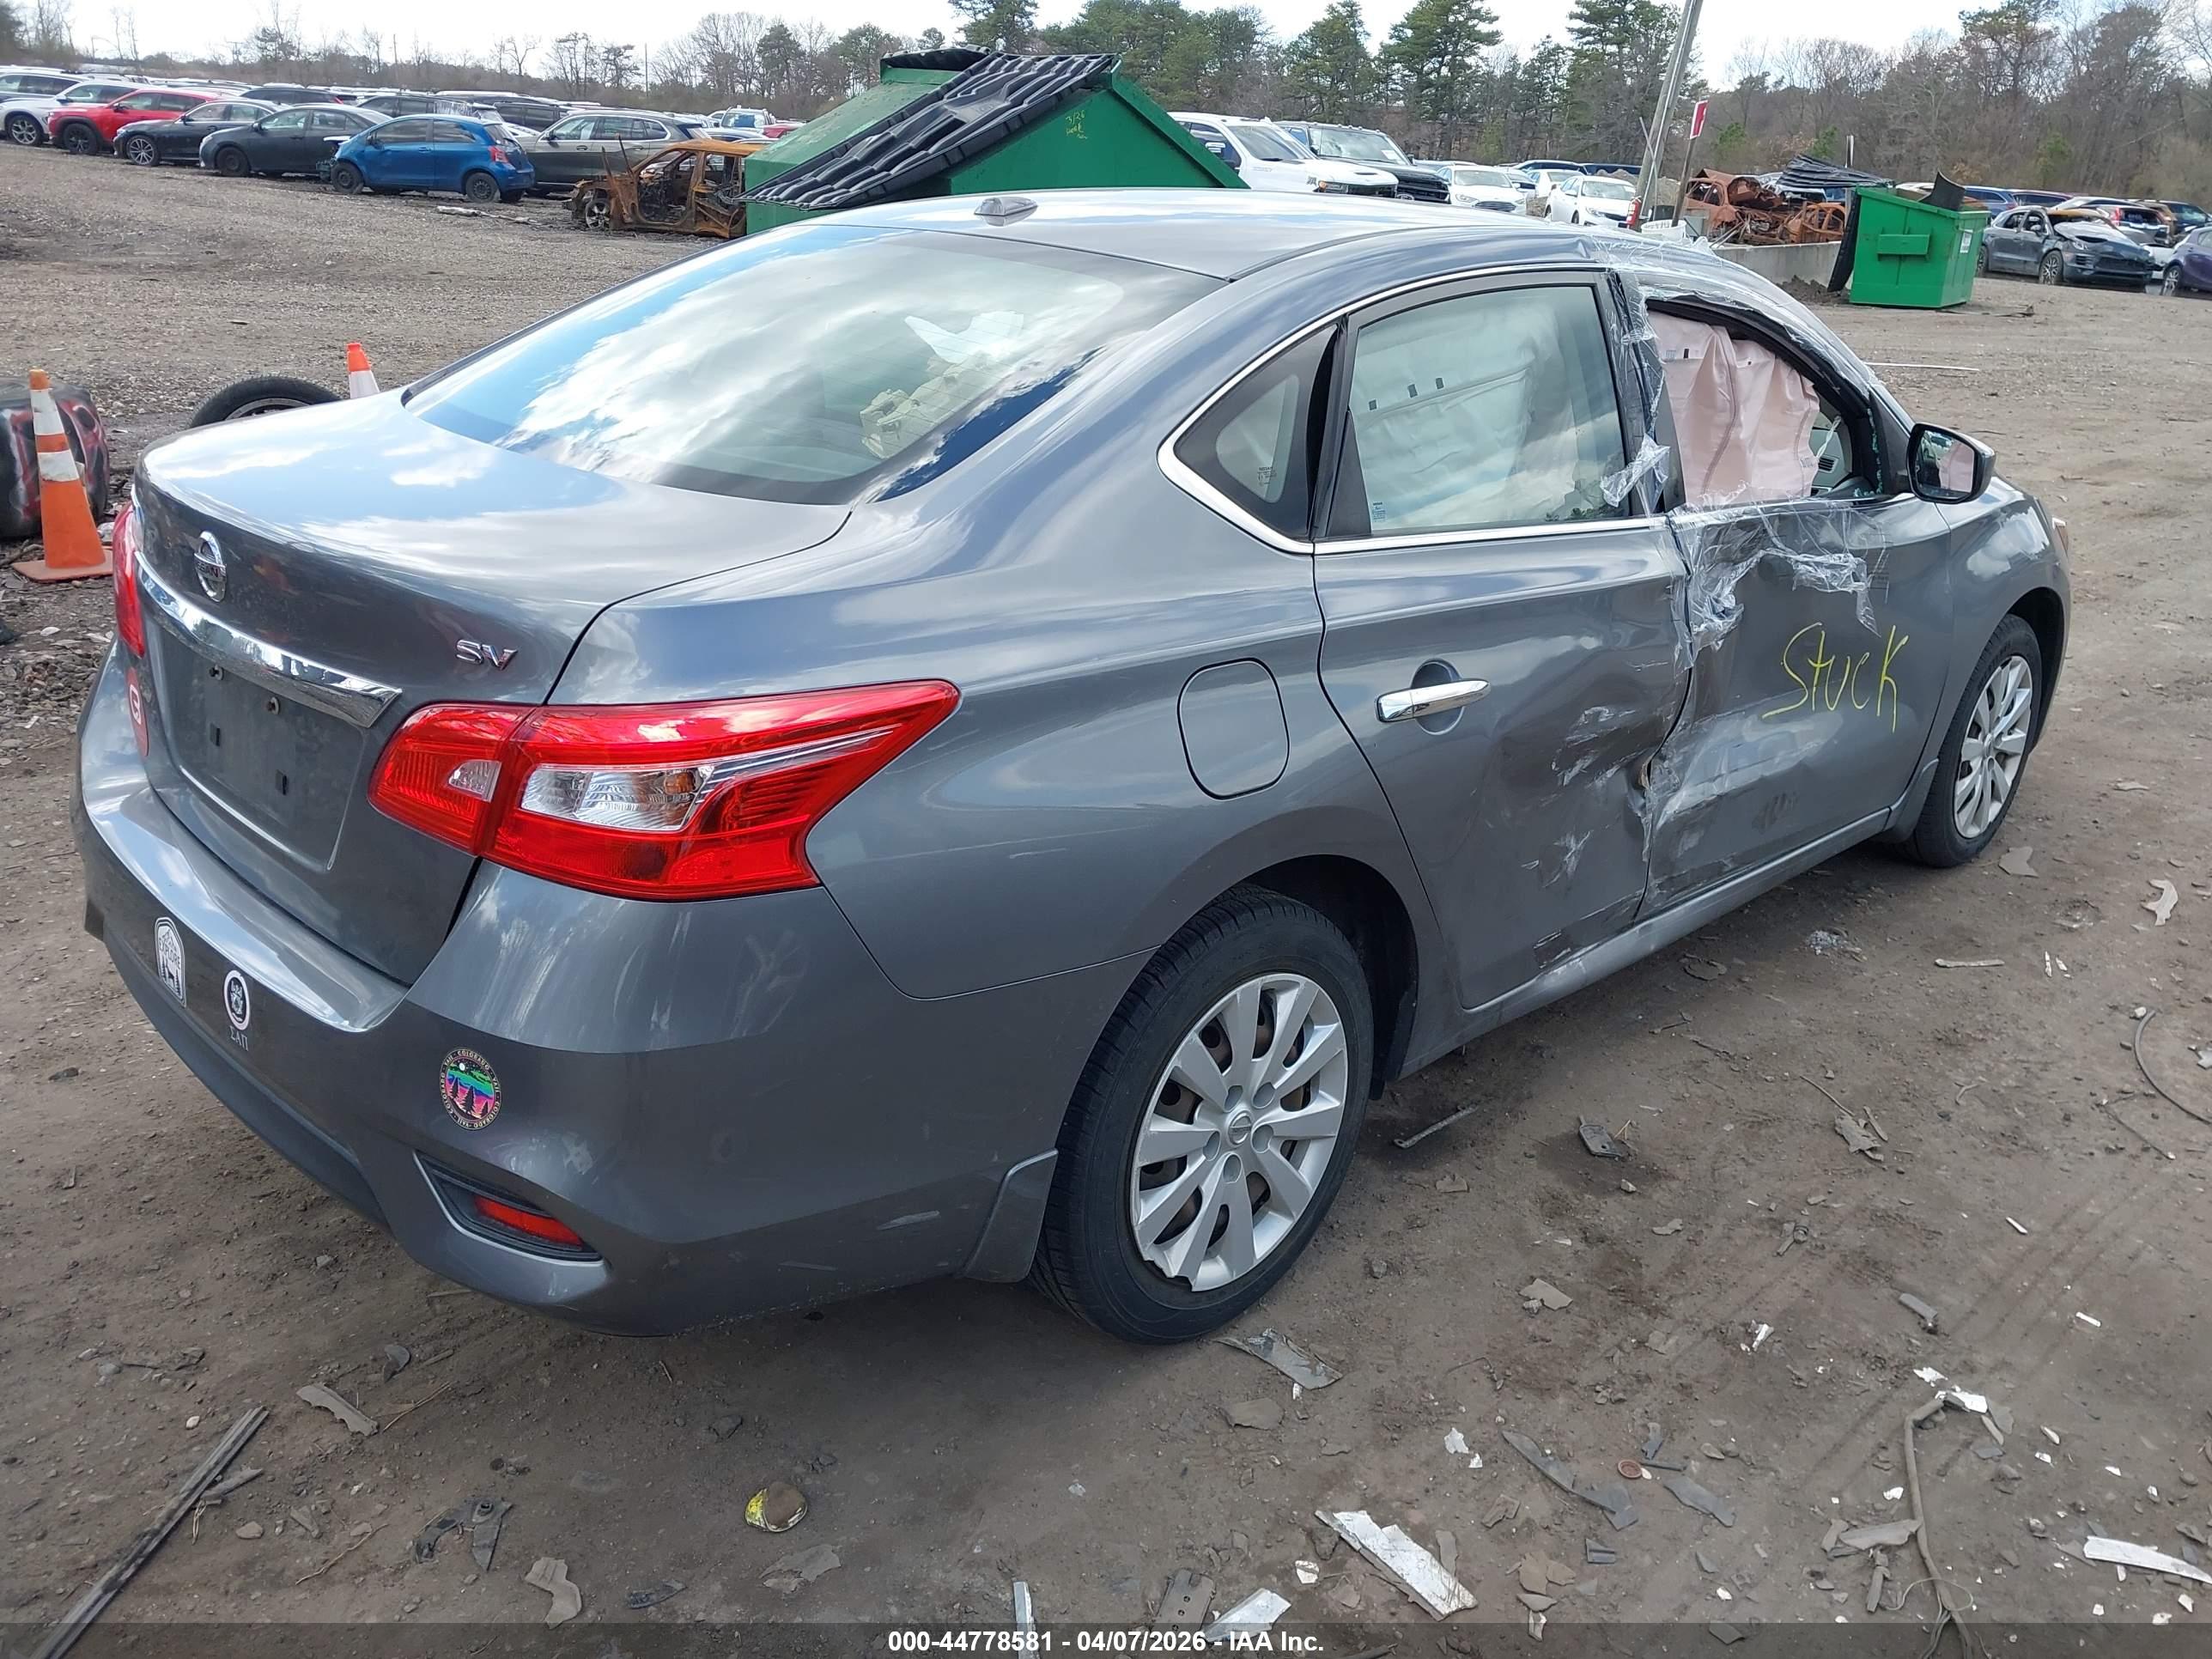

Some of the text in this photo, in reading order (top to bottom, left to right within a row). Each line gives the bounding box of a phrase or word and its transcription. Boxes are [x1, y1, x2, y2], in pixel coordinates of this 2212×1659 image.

[455, 639, 519, 671] SV
[158, 936, 182, 970] EXPLORE
[457, 1049, 490, 1071] COLORADO
